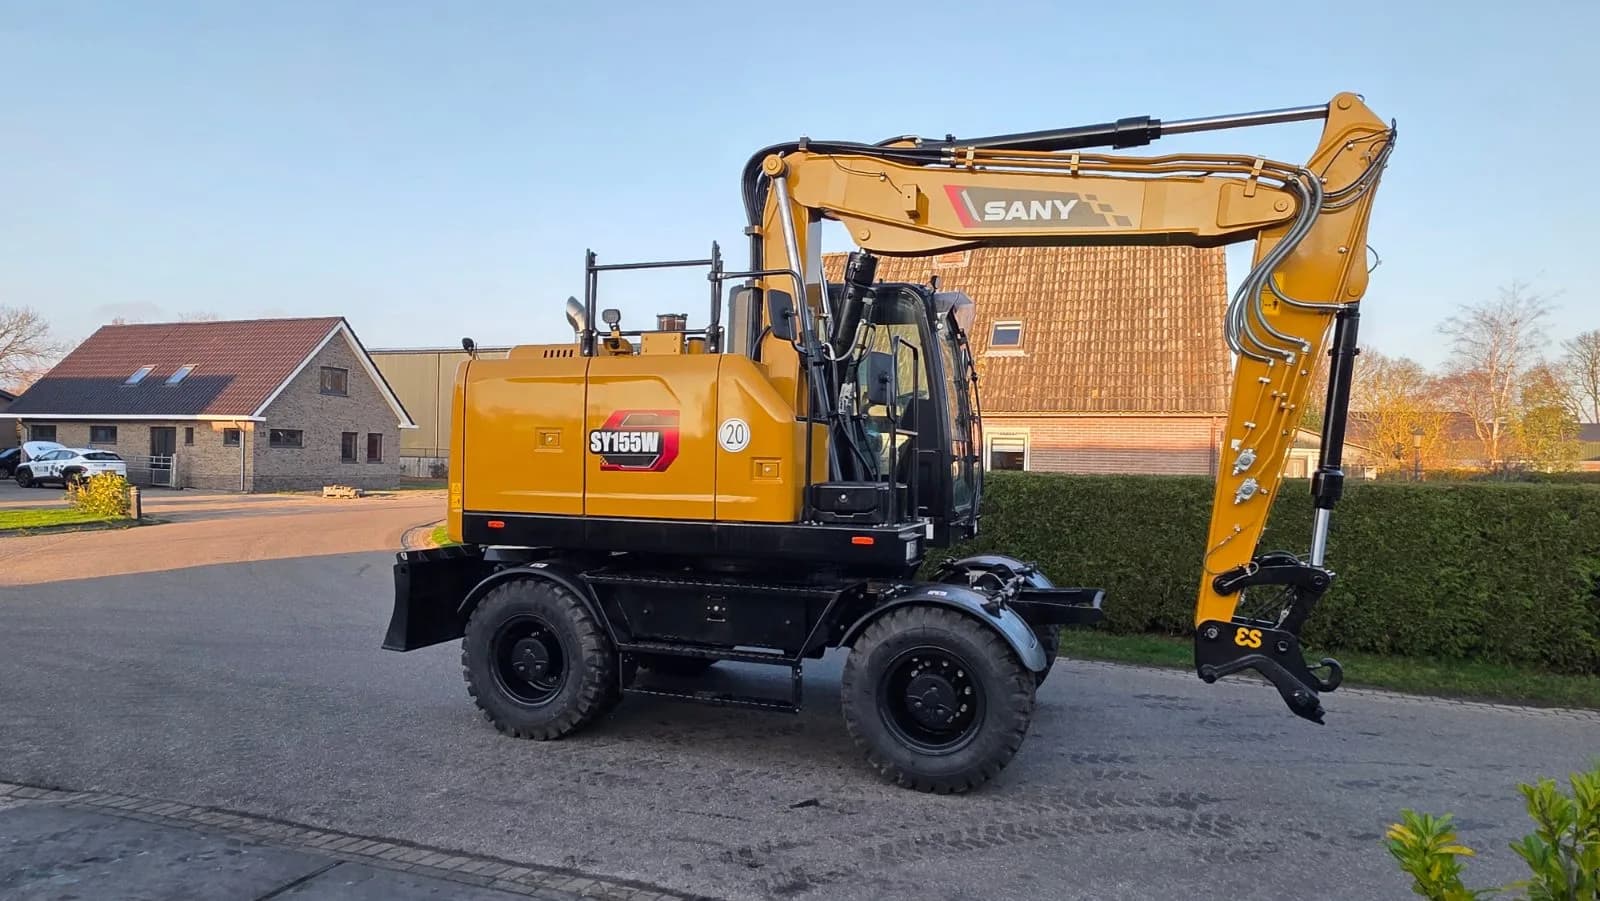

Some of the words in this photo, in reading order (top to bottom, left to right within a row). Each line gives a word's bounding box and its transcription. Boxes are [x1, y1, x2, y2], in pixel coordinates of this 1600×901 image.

[984, 199, 1078, 221] SANY
[590, 431, 660, 453] SY155W
[726, 424, 744, 444] 20
